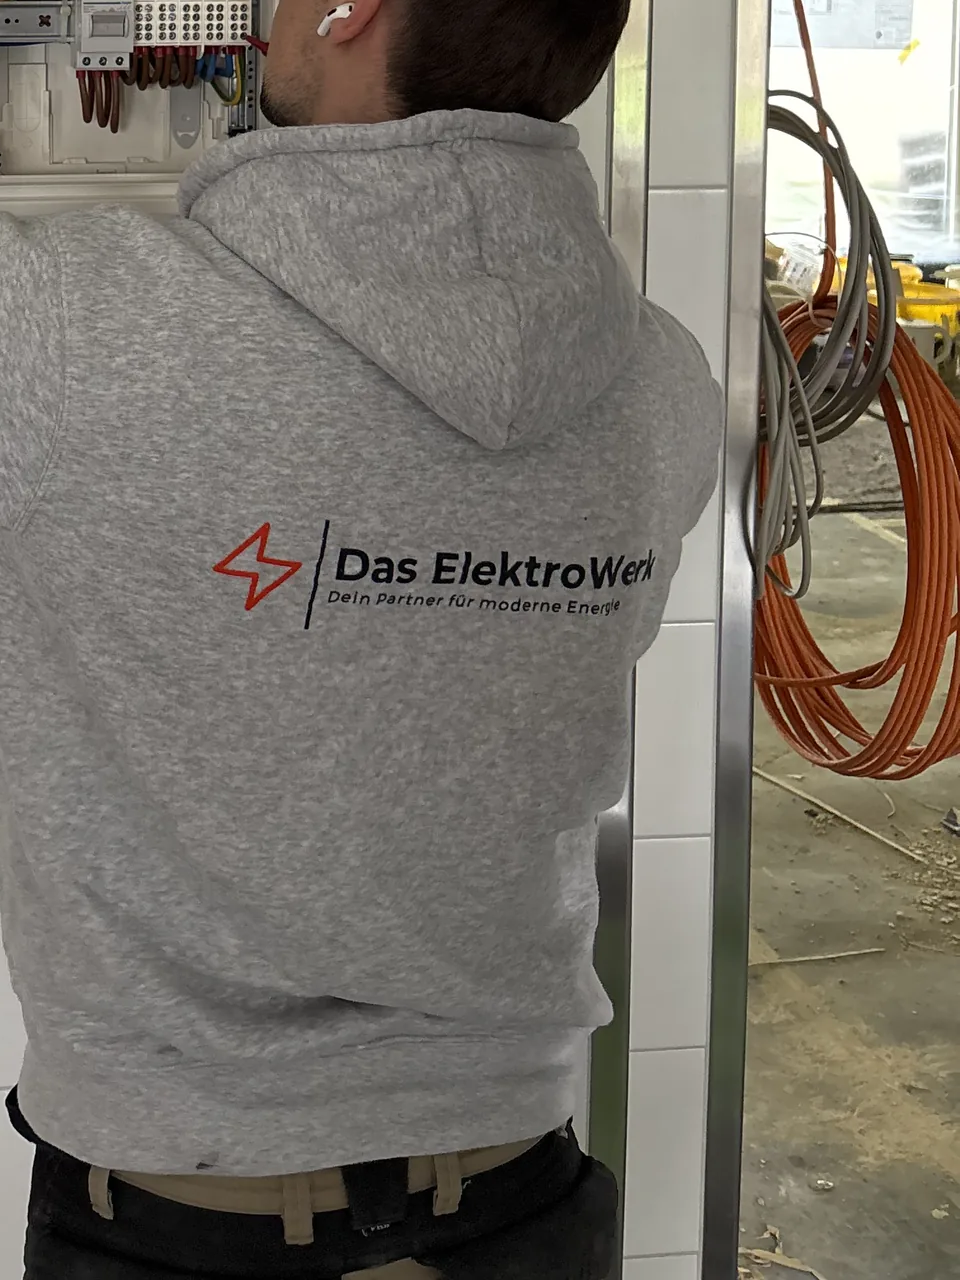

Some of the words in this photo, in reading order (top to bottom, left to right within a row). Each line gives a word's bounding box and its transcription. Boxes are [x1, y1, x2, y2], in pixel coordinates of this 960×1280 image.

[335, 547, 418, 584] Das
[431, 548, 656, 590] ElektroWerk
[327, 590, 371, 606] Dein
[376, 594, 444, 607] Partner
[448, 594, 475, 608] für
[478, 598, 561, 614] moderne
[566, 598, 621, 617] Energie
